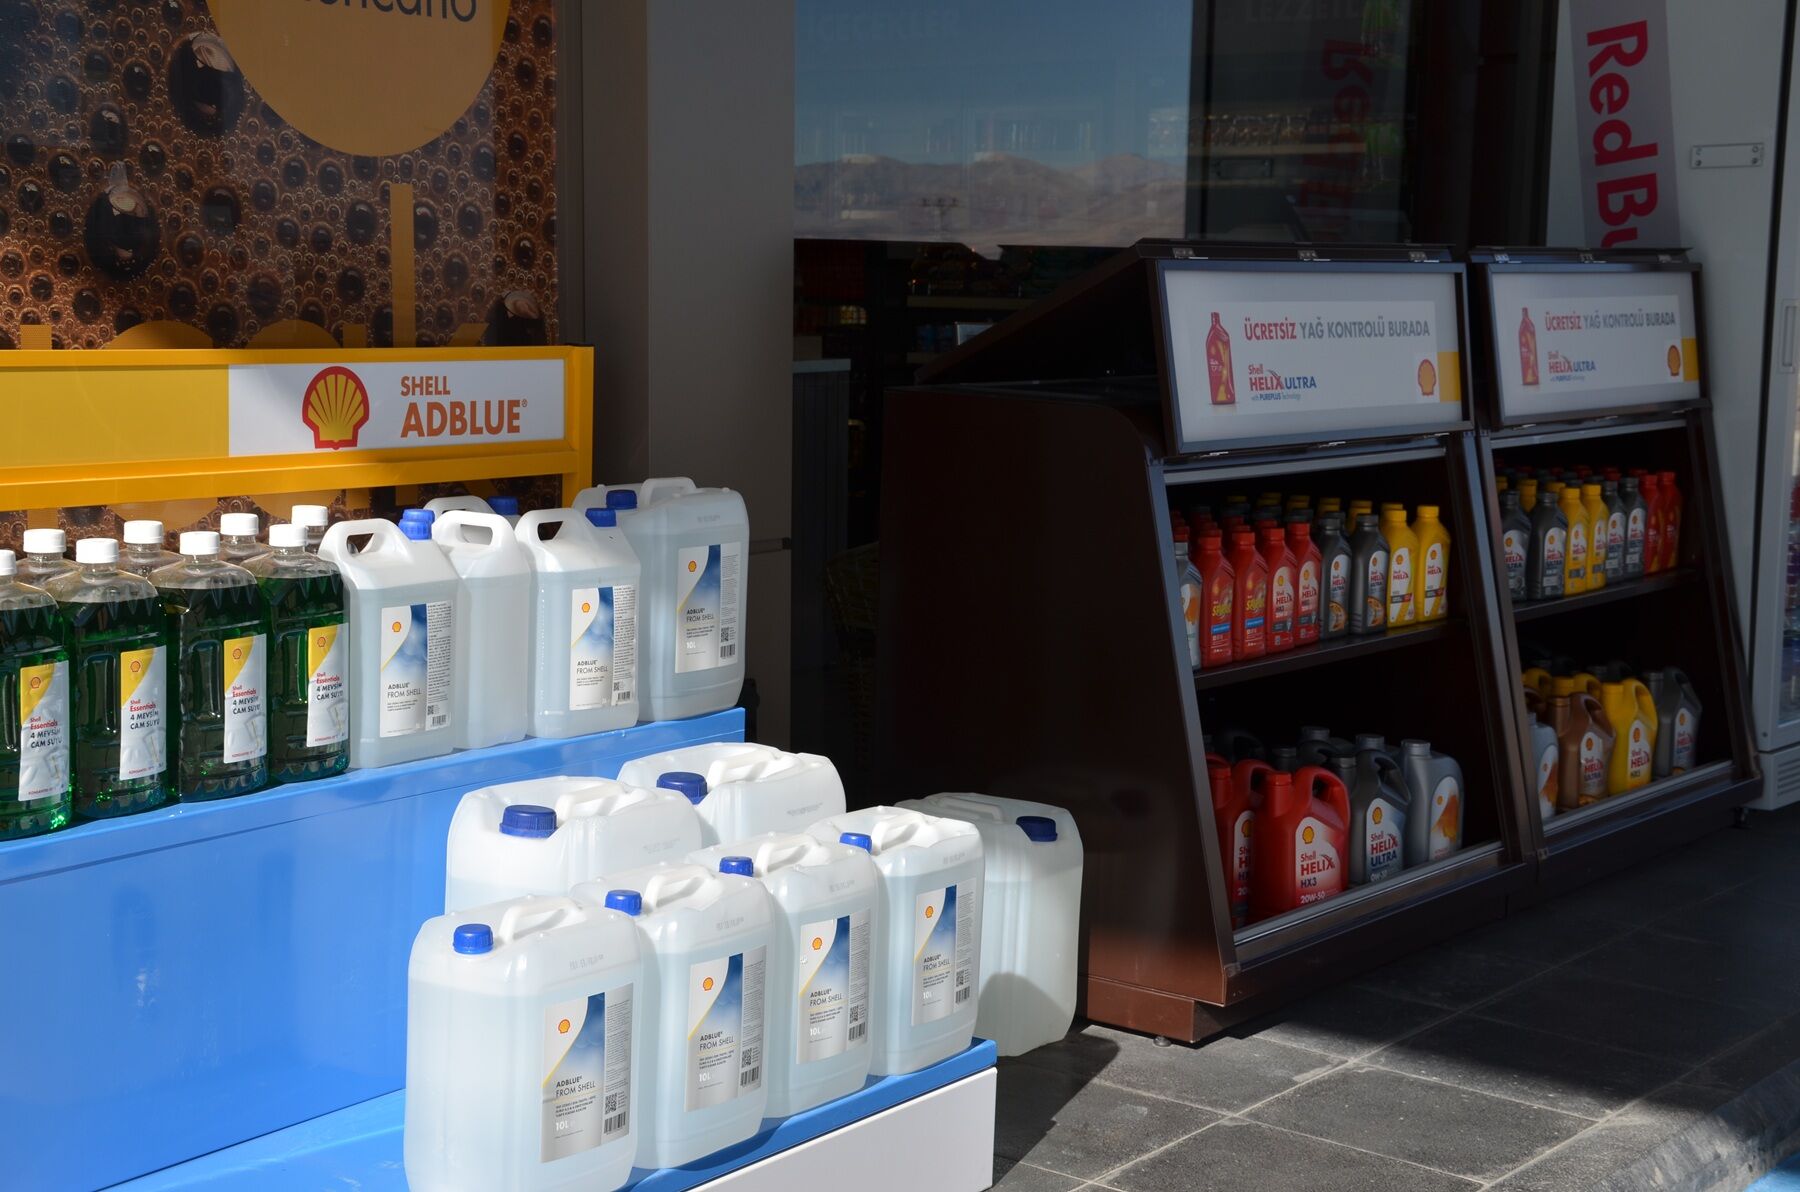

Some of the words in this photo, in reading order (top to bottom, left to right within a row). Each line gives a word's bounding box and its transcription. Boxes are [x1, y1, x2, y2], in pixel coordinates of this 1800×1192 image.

[1587, 20, 1658, 167] Red
[1545, 311, 1582, 331] ÜCRETSİZ
[1602, 309, 1644, 327] KONTROLÜ
[1646, 312, 1676, 327] BURADA
[1244, 317, 1297, 340] ÜCRETSİZ
[1299, 316, 1324, 340] YAĞ
[1327, 316, 1385, 339] KONTROLÜ
[1388, 320, 1430, 338] BURADA
[1248, 363, 1264, 375] Shell
[400, 375, 451, 396] SHELL
[1249, 372, 1284, 391] HELIX
[1284, 376, 1318, 390] ULTRA
[701, 613, 714, 621] SHELL
[316, 693, 330, 701] CAM
[387, 690, 405, 698] FROM
[406, 688, 422, 696] SHELL
[129, 703, 157, 713] Essentials
[232, 706, 247, 715] CAM
[30, 719, 58, 730] Essentials
[130, 721, 145, 730] CAM
[31, 740, 46, 749] CAM
[1371, 834, 1398, 855] HELIX
[1300, 851, 1316, 862] Shell
[1371, 850, 1397, 867] ULTRA
[1300, 855, 1335, 876] HELIX
[1300, 877, 1317, 888] HX3
[923, 962, 937, 971] FROM
[938, 958, 951, 967] SHELL
[809, 997, 826, 1007] FROM
[828, 993, 843, 1002] SHELL
[699, 1041, 717, 1051] FROM
[718, 1035, 734, 1046] SHELL
[555, 1086, 576, 1098] FROM
[577, 1080, 596, 1092] SHELL
